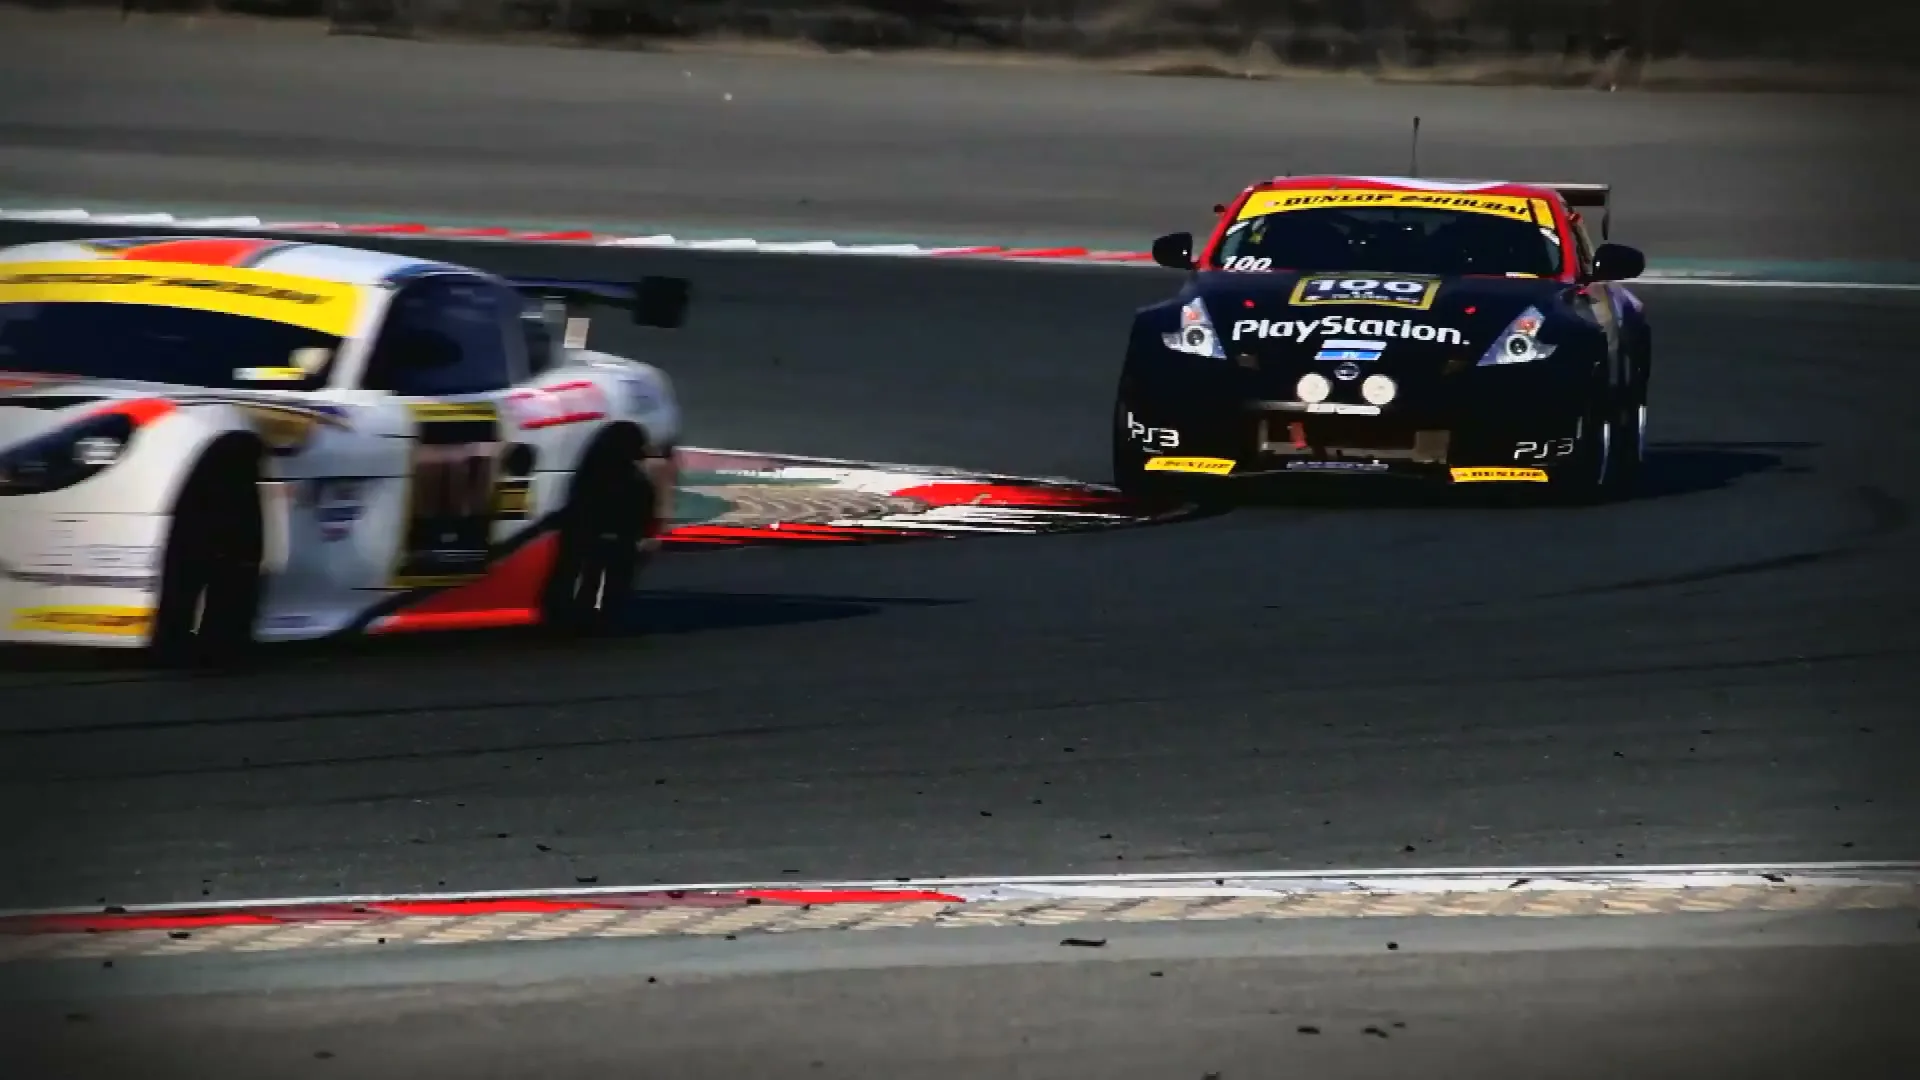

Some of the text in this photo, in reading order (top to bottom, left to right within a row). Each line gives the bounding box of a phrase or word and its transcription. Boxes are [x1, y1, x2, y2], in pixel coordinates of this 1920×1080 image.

[1284, 193, 1393, 206] DUNLOP
[1223, 255, 1272, 272] 100
[1311, 279, 1423, 293] 100
[1129, 420, 1180, 447] PS3
[1513, 437, 1574, 460] PS3
